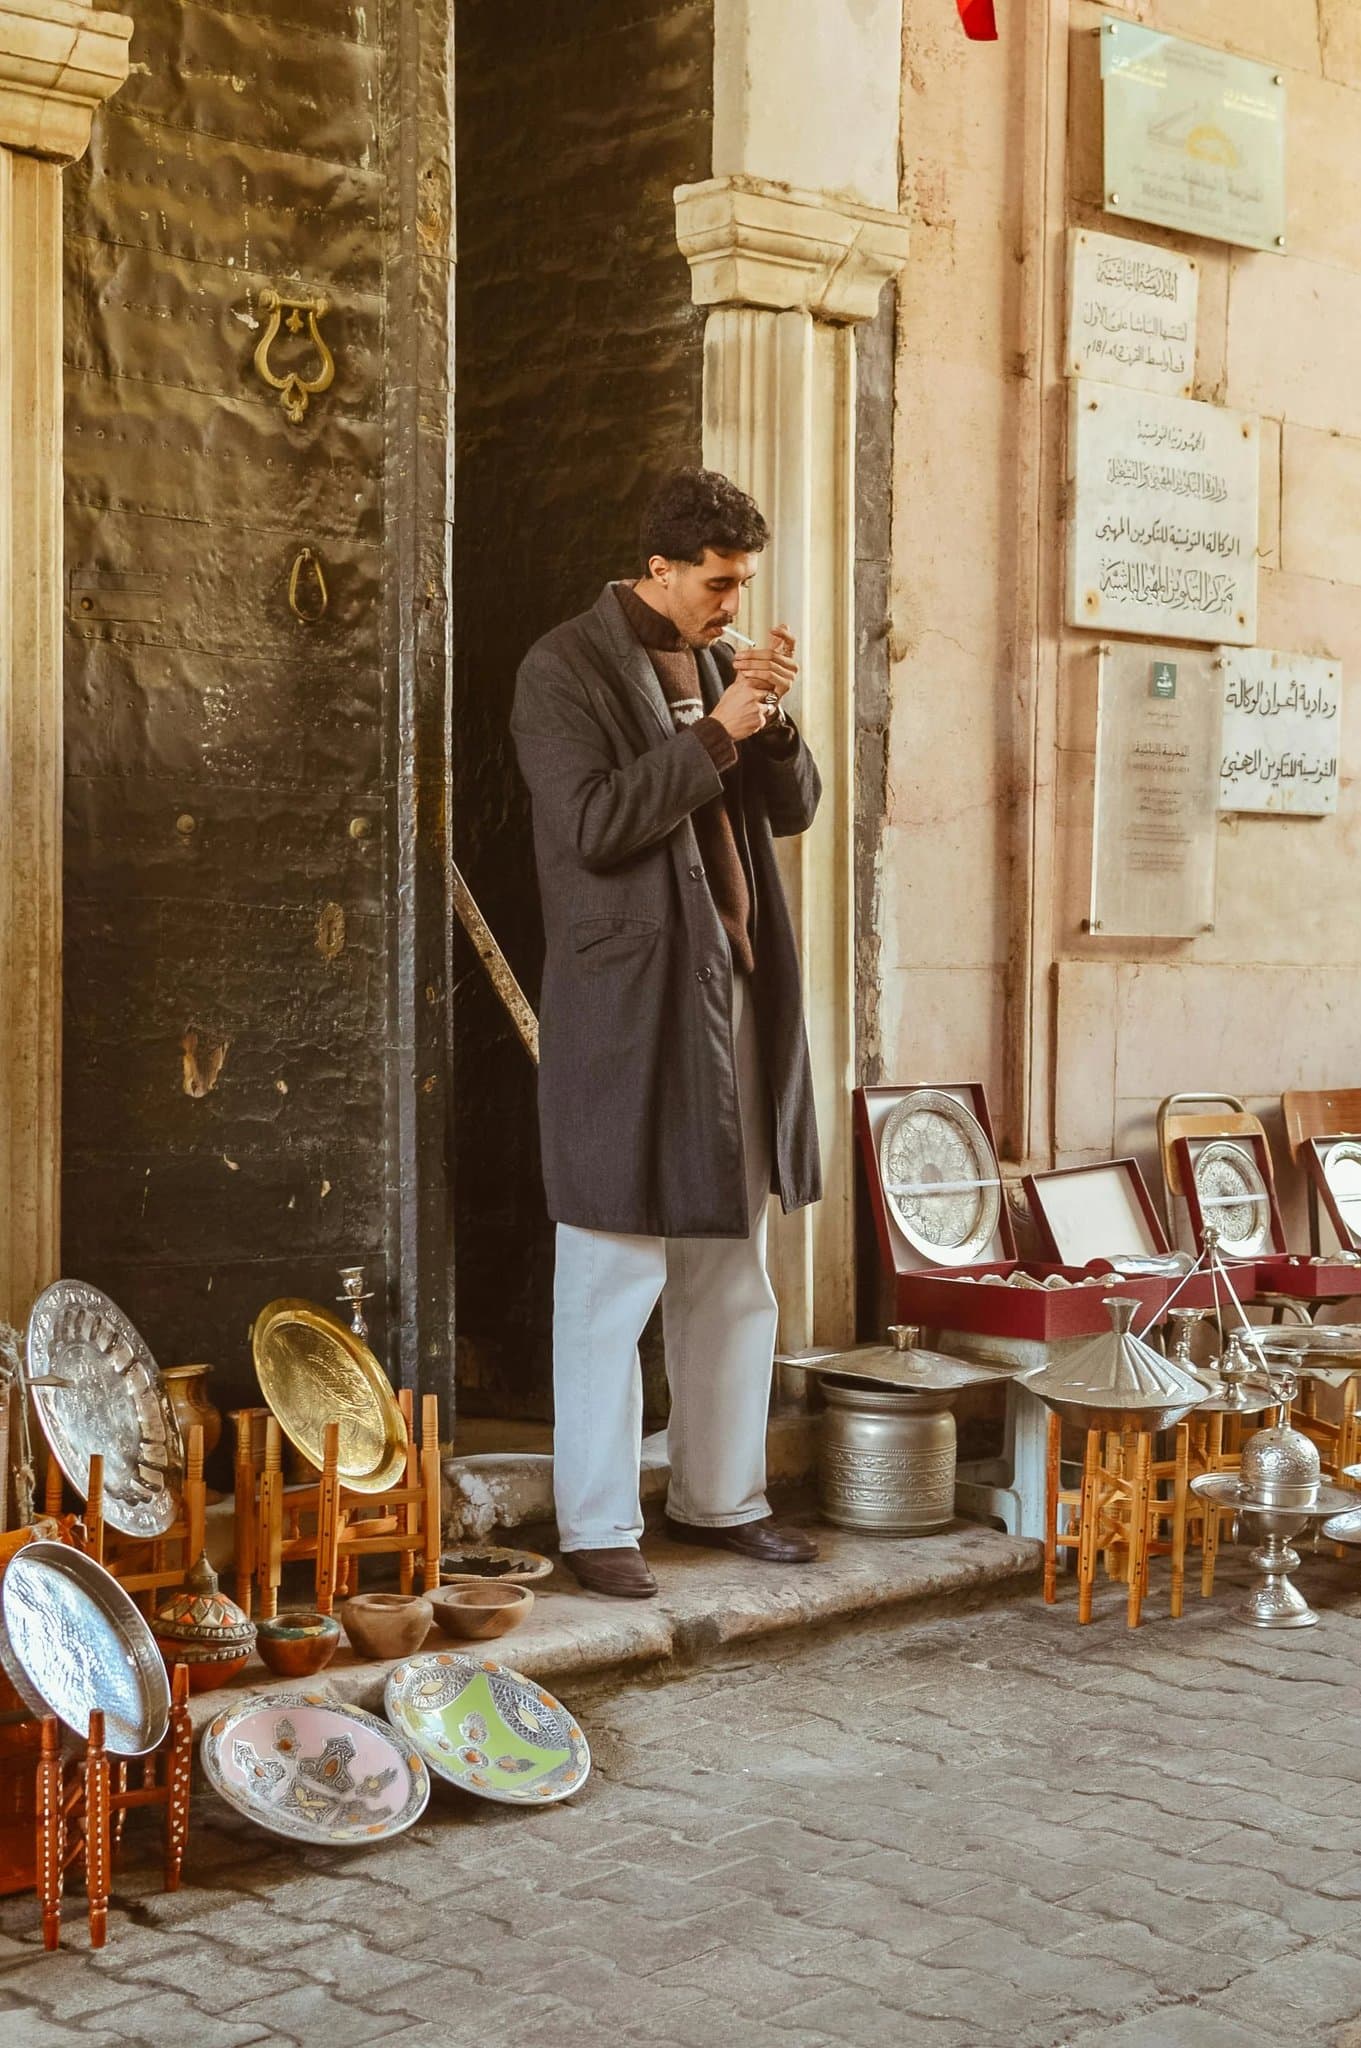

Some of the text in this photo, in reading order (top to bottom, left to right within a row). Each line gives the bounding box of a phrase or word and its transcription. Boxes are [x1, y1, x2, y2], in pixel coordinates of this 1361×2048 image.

[1130, 311, 1160, 337] الباشا
[1136, 419, 1206, 453] الجمهورية التونسية
[1171, 471, 1205, 499] التكوين
[1202, 472, 1228, 503] وزارة
[1095, 516, 1240, 558] الوكالة التونسية للتكوين المهني
[1099, 558, 1237, 616] مركز التكوين المهني الباشية
[1225, 677, 1337, 719] ودادية أعوان الوكالة
[1219, 748, 1337, 788] التونسية للتكوين المهني
